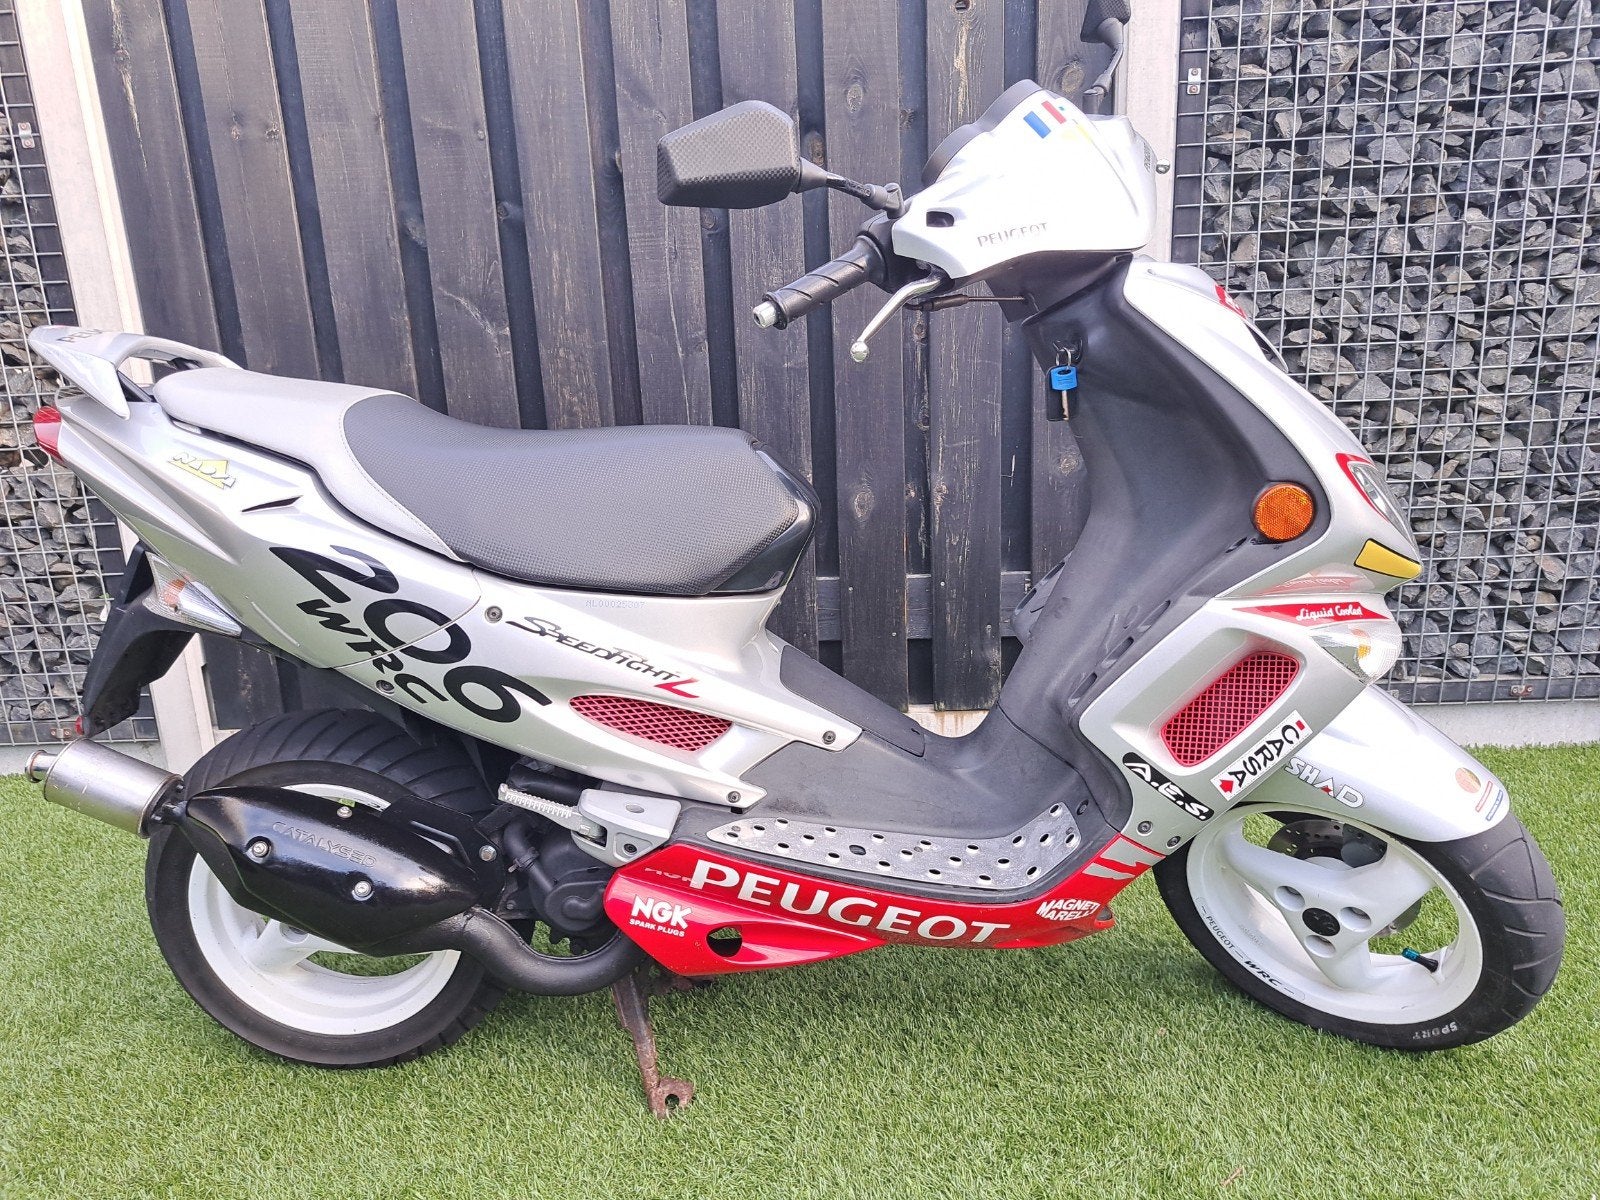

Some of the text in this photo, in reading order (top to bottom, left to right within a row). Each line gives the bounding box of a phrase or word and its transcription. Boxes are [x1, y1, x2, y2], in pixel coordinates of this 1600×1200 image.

[977, 222, 1048, 248] PEUGEOT
[269, 544, 553, 723] 206
[1296, 604, 1363, 621] Liquid Cooled
[296, 599, 449, 704] WRC
[1228, 724, 1300, 788] CARSA
[1284, 756, 1365, 808] SHAD
[273, 821, 377, 868] CATALYSED
[631, 894, 693, 930] NGK
[689, 858, 1011, 943] PEUGEOT
[629, 918, 685, 938] SPARK PLUGS
[1206, 915, 1235, 949] PEUGEOT
[1244, 960, 1283, 987] WRC
[1412, 1021, 1458, 1040] SPORT
